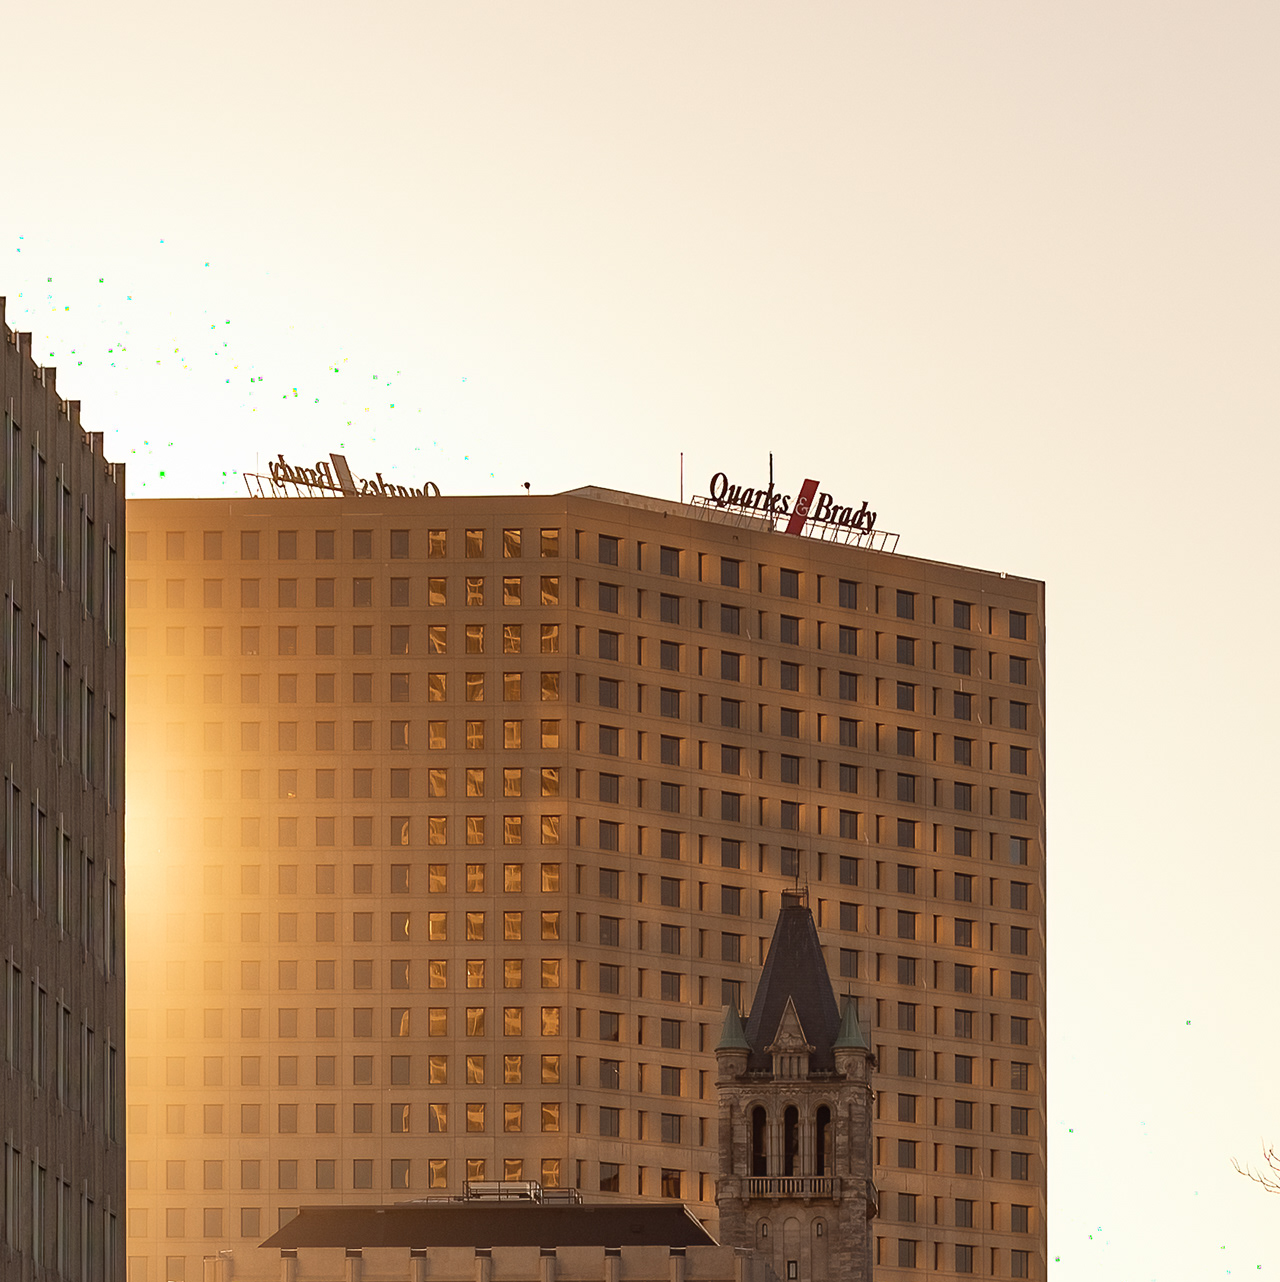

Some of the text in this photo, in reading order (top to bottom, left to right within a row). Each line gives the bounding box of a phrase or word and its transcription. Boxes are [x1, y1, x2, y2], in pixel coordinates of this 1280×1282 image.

[709, 471, 877, 535] Quarles & Brady
